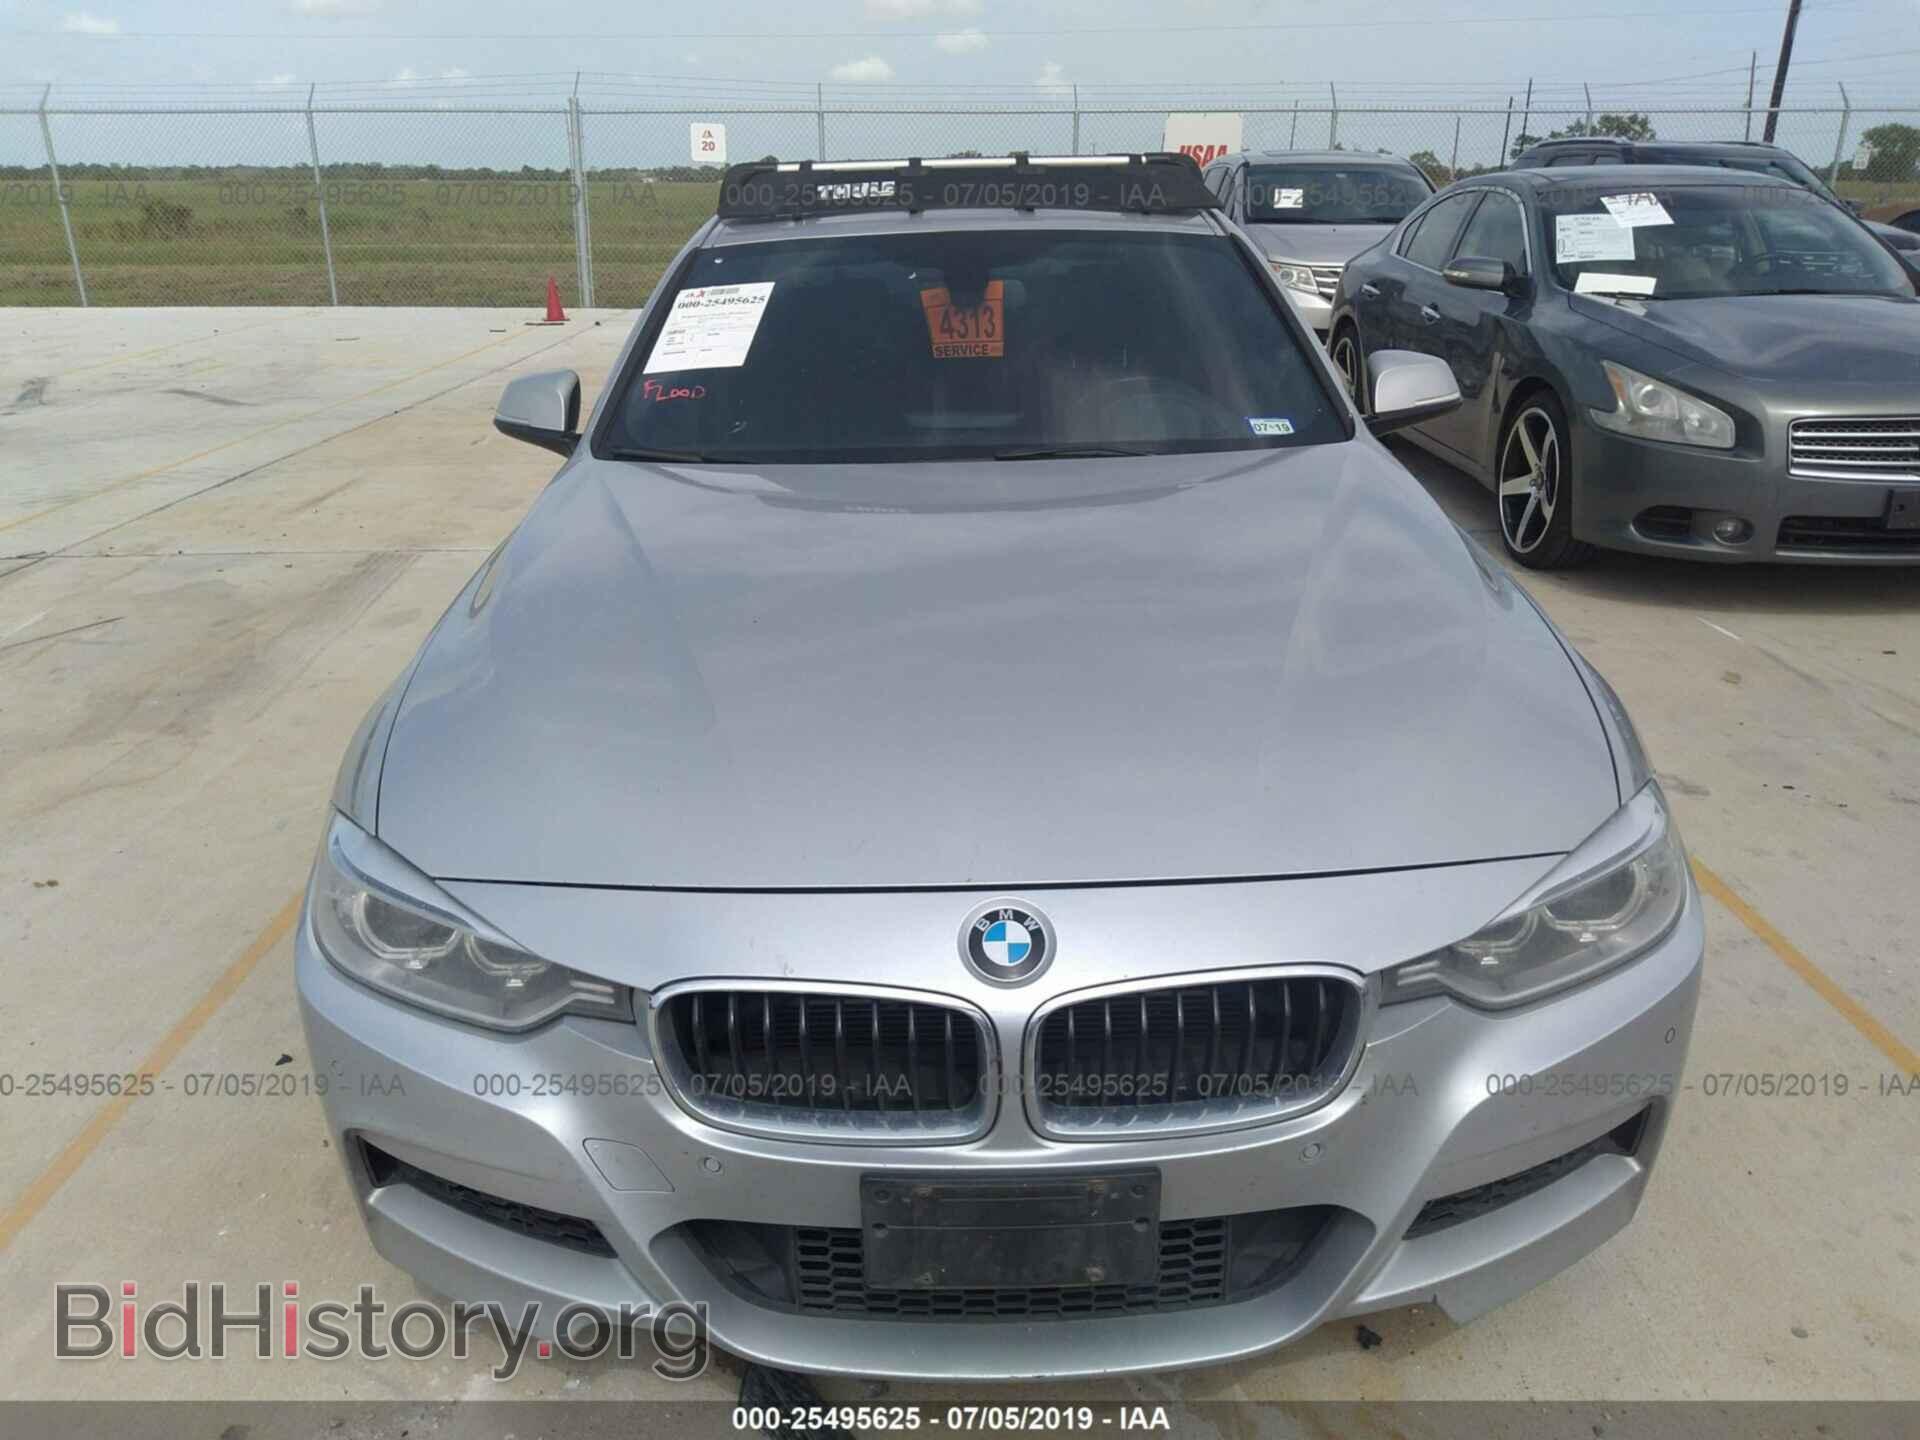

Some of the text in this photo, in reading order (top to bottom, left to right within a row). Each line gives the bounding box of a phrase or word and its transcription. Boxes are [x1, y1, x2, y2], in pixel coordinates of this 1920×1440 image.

[702, 140, 715, 151] 20
[941, 305, 996, 339] 4313
[934, 343, 989, 356] SERVICE
[643, 379, 705, 401] FLOOD
[975, 909, 1041, 932] BMW
